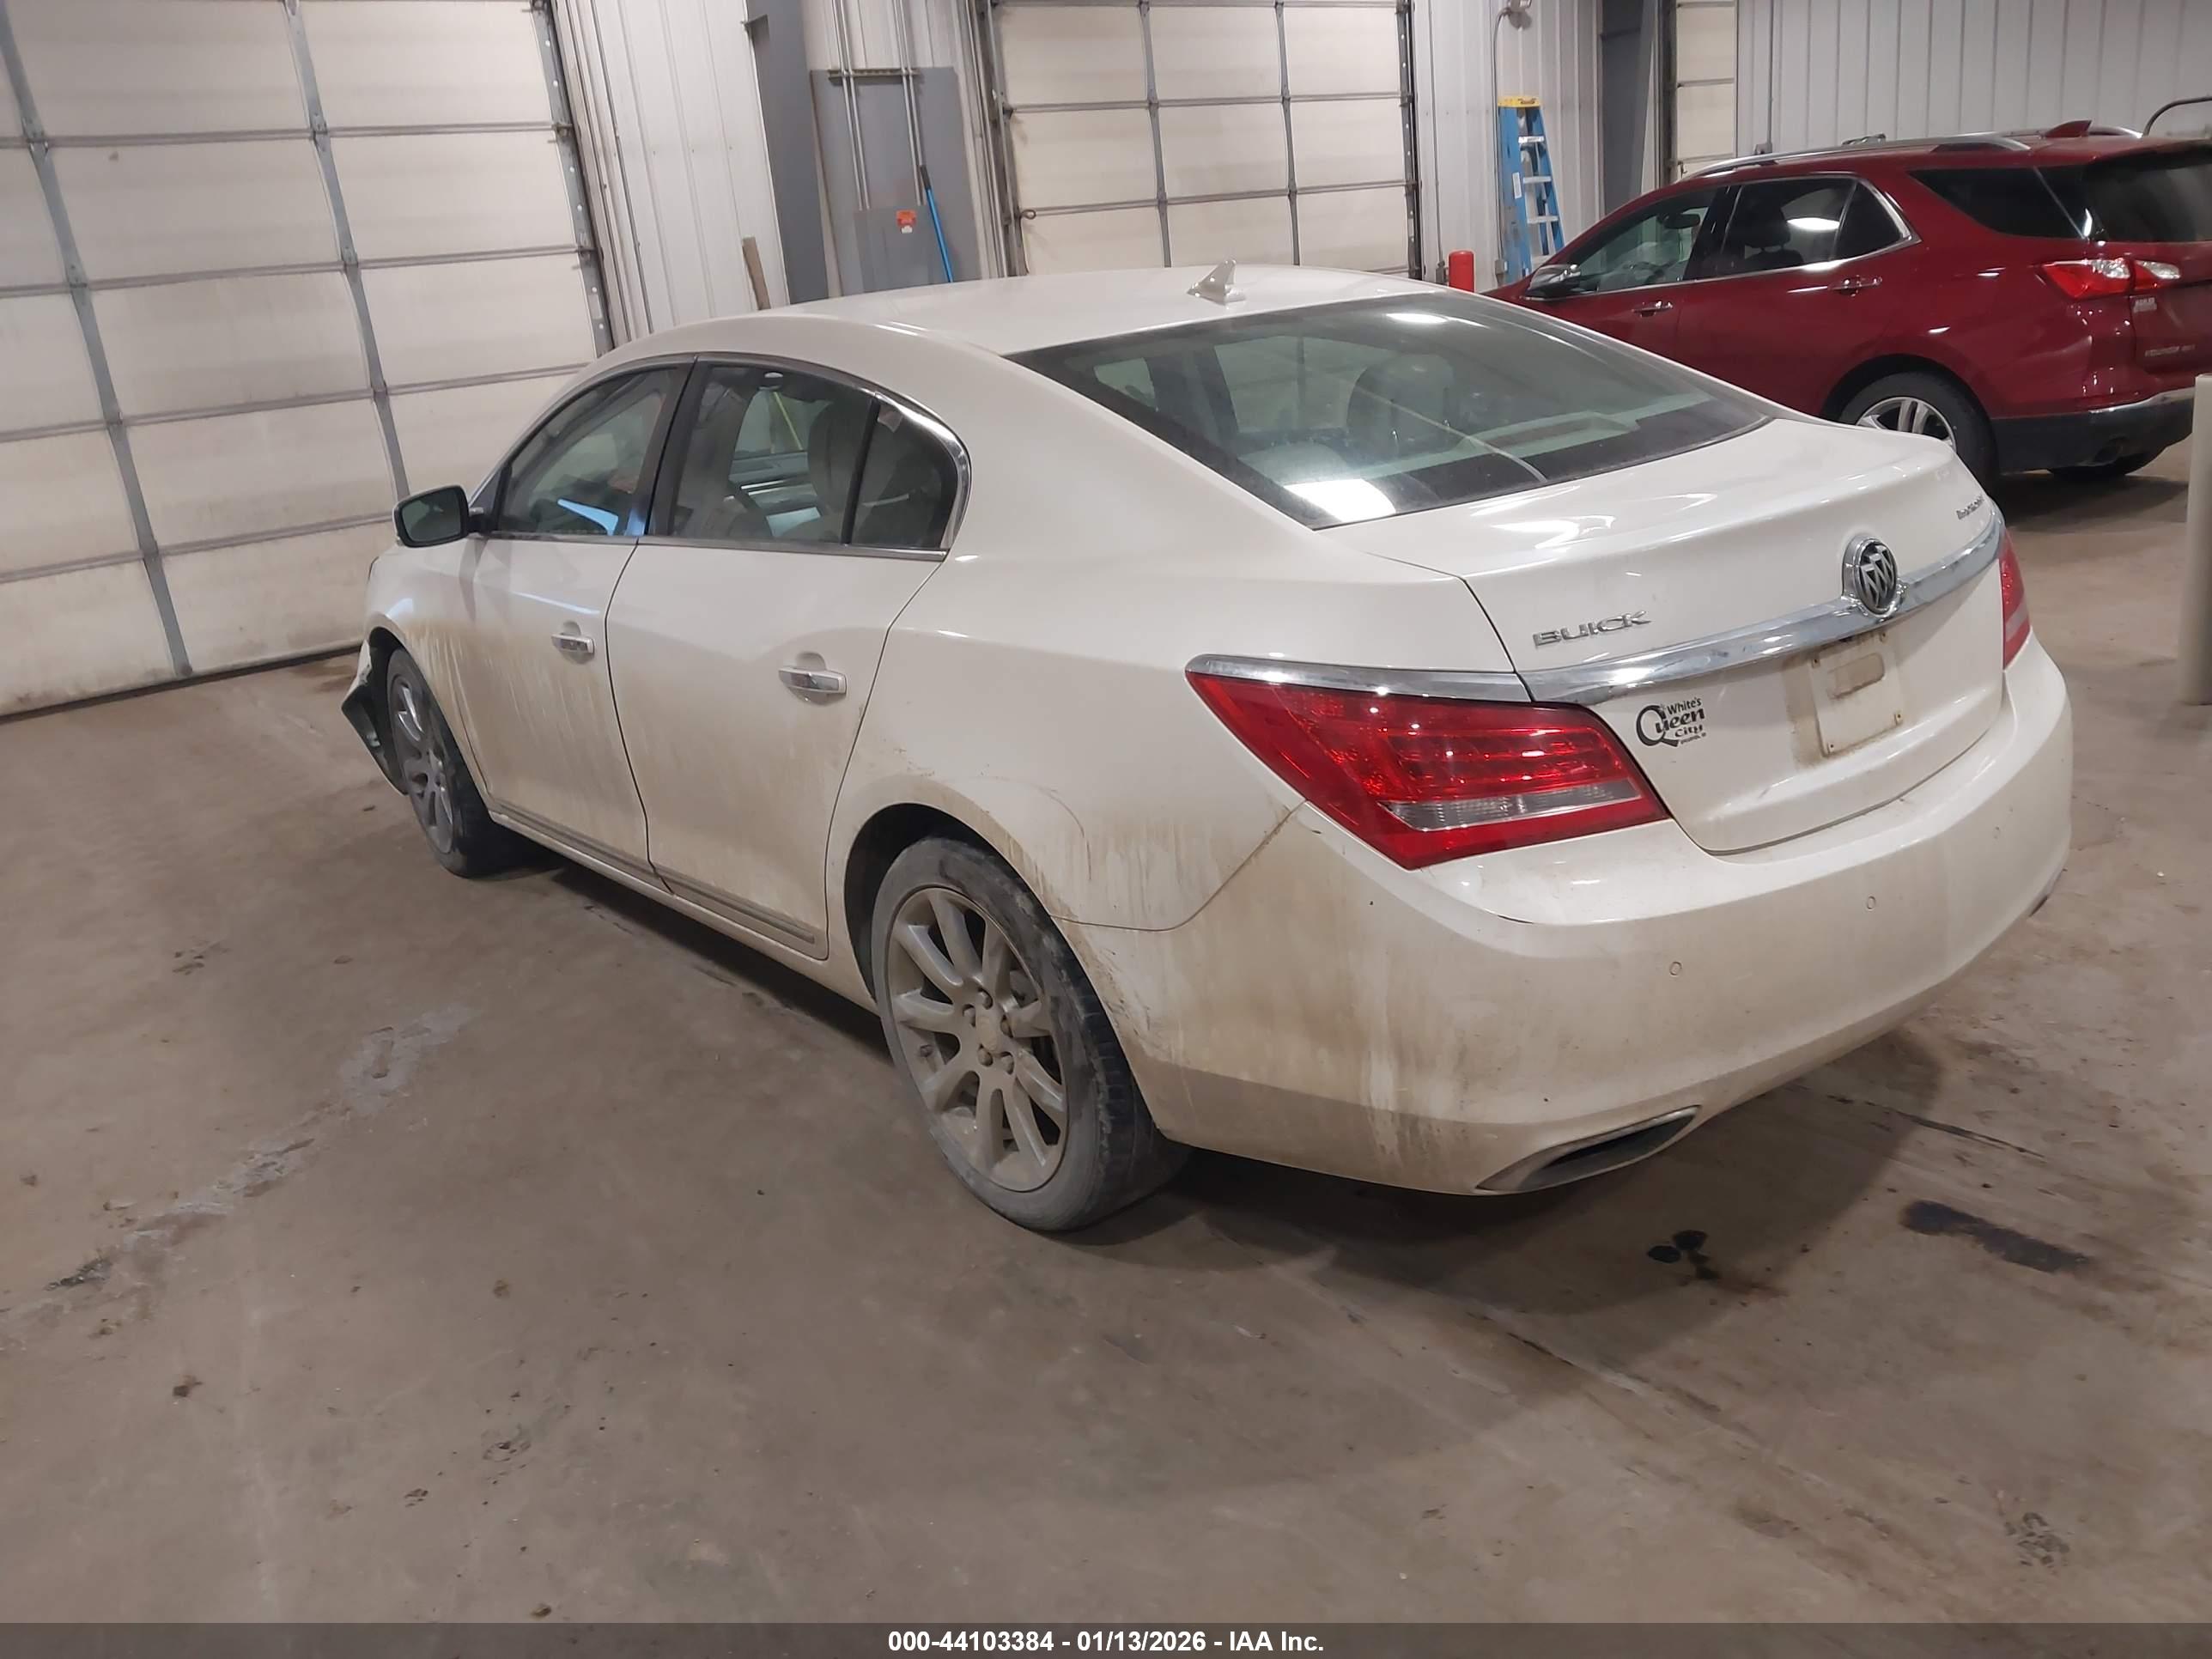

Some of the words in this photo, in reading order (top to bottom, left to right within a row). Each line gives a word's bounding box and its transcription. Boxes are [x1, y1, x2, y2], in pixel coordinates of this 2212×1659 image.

[1533, 610, 1652, 647] BUICK
[1667, 697, 1702, 714] White's
[1636, 705, 1705, 747] Queen
